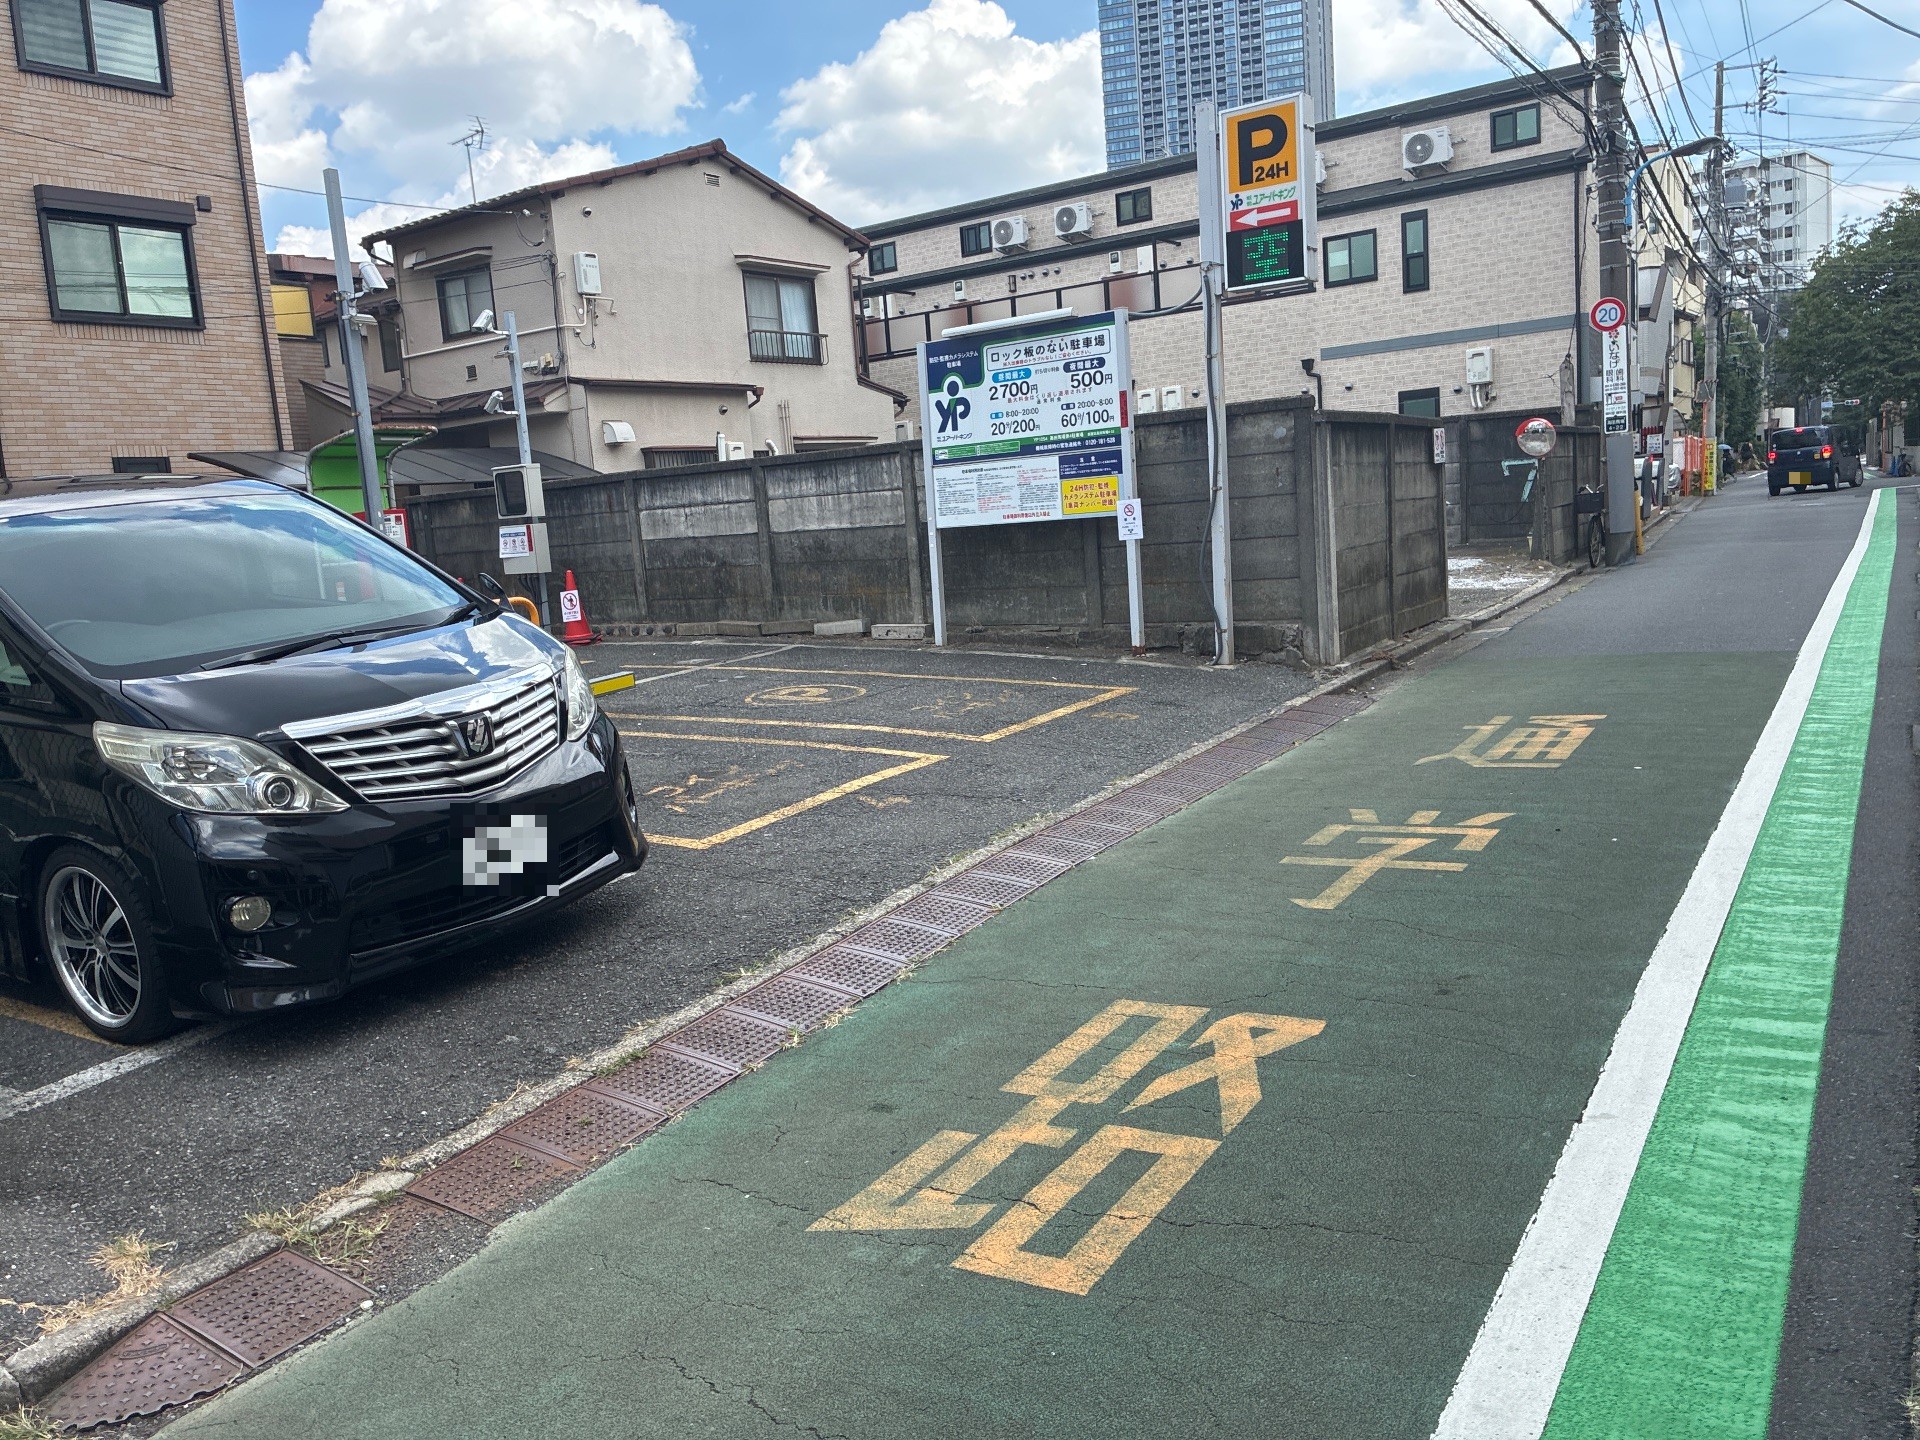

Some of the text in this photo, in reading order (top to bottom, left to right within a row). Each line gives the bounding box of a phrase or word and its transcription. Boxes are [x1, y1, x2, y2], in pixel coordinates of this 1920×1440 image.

[1237, 114, 1288, 186] P
[1255, 161, 1289, 183] 24H
[1244, 229, 1289, 281] 空
[1598, 306, 1618, 323] 20
[991, 334, 1105, 363] ロック板のない駐車場
[1608, 343, 1620, 368] いなげ
[1069, 359, 1100, 371] 夜間最大
[1070, 370, 1113, 389] 500円
[989, 381, 1039, 401] 2700円
